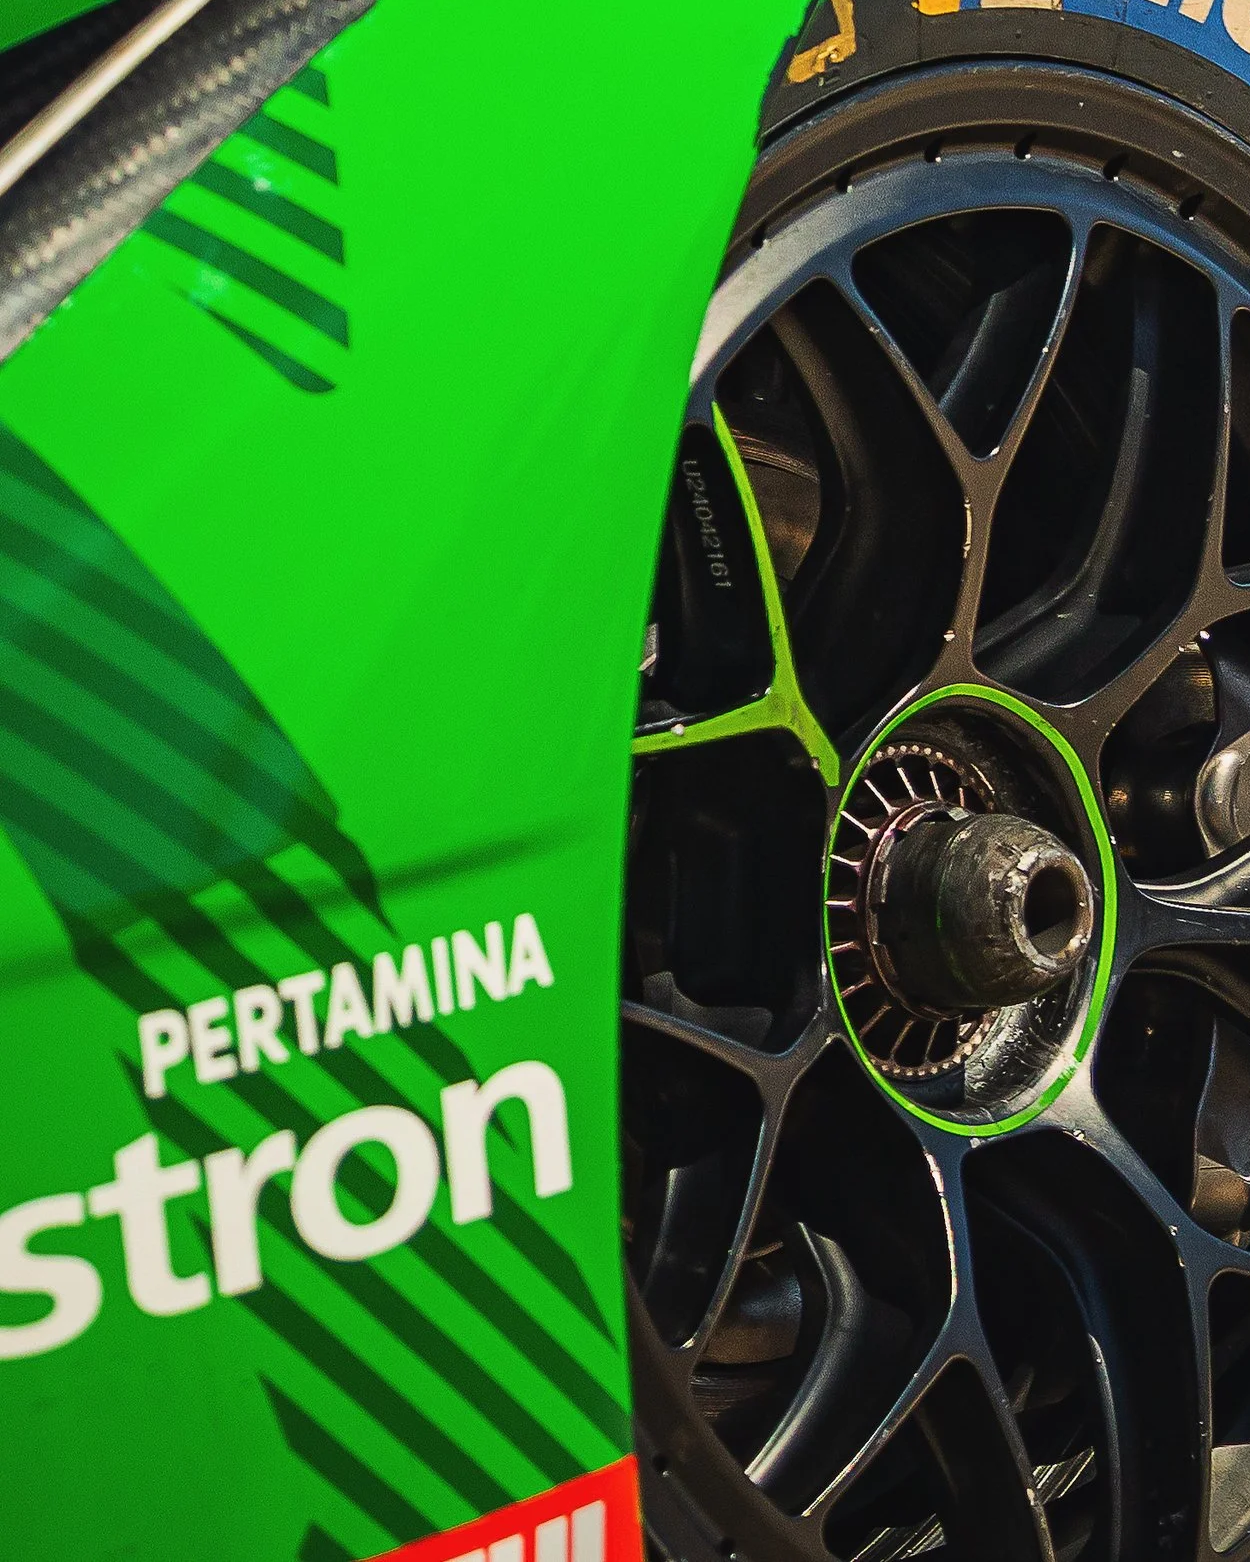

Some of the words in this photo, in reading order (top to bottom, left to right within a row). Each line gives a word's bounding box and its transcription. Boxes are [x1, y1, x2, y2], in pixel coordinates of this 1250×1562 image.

[683, 460, 732, 587] U24042161
[138, 913, 554, 1099] PERTAMINA
[0, 1060, 573, 1361] stron
